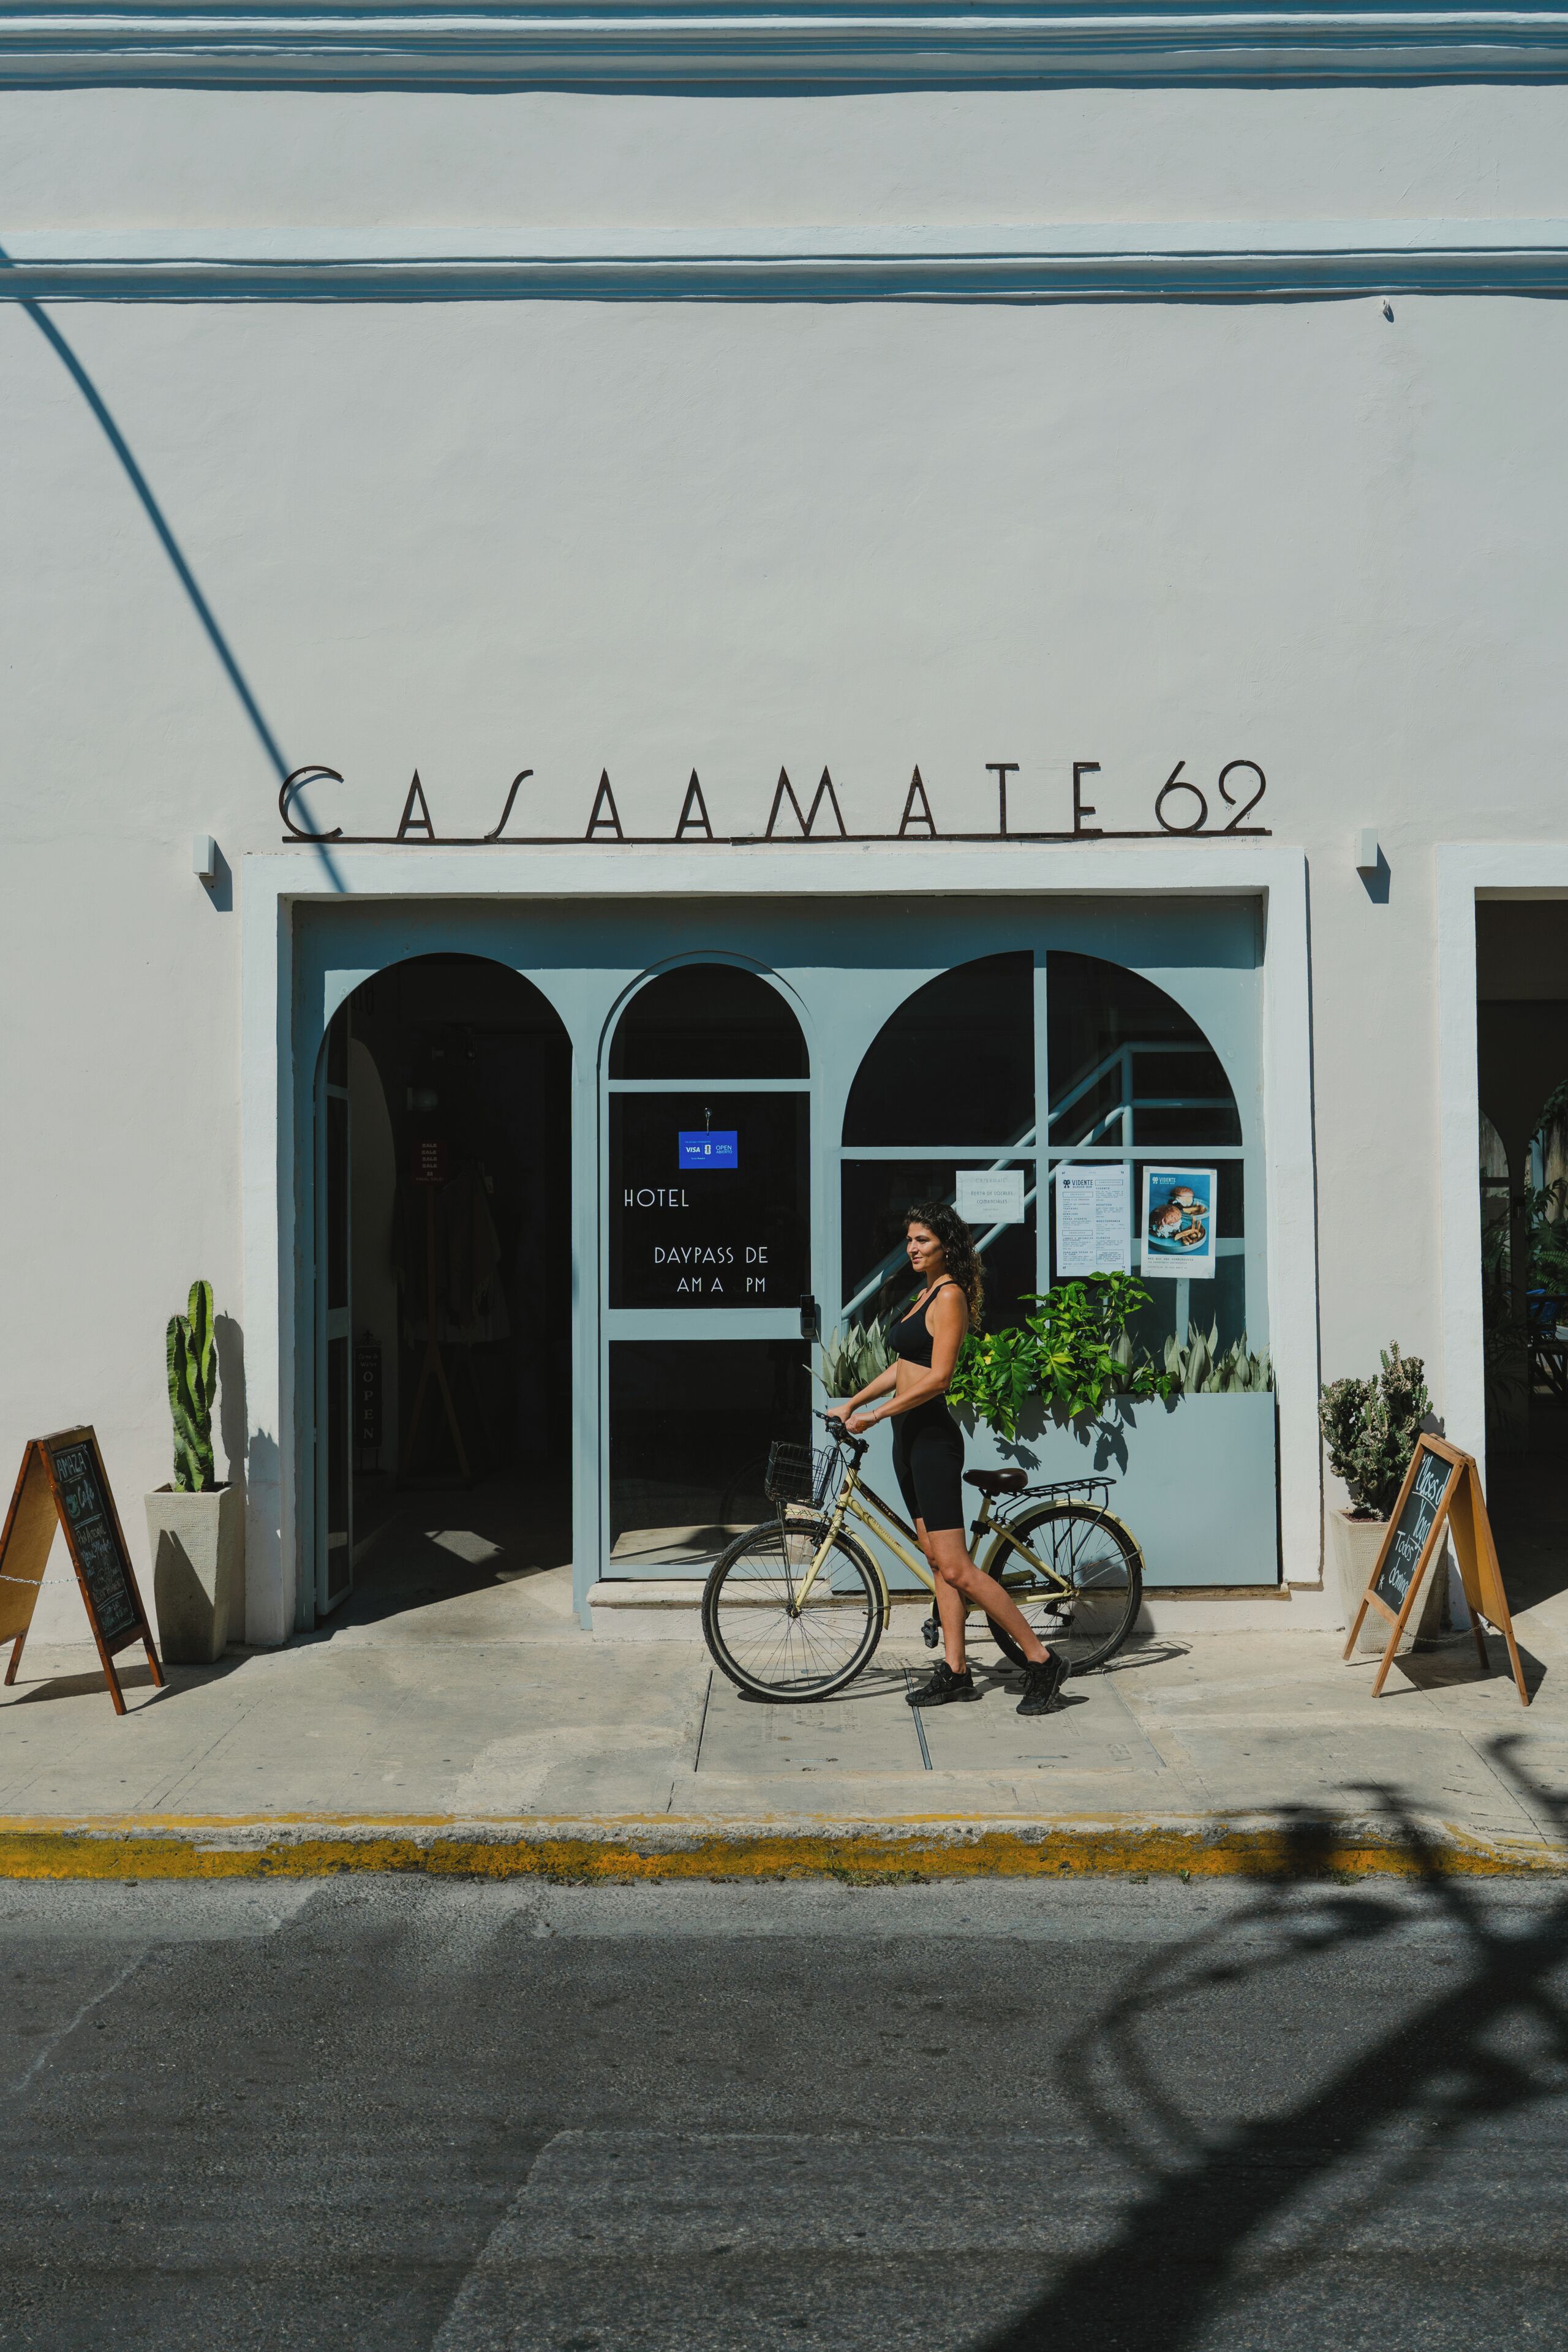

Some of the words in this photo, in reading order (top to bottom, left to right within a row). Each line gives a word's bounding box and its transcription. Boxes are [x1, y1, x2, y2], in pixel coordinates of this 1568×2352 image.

[625, 1189, 689, 1207] HOTEL
[655, 1247, 734, 1264] DAYPASS
[746, 1247, 768, 1263] DE
[677, 1277, 702, 1292] AM
[710, 1277, 723, 1292] A
[746, 1277, 766, 1292] PM
[362, 1371, 374, 1439] OPEN
[56, 1452, 87, 1481] AMAZA
